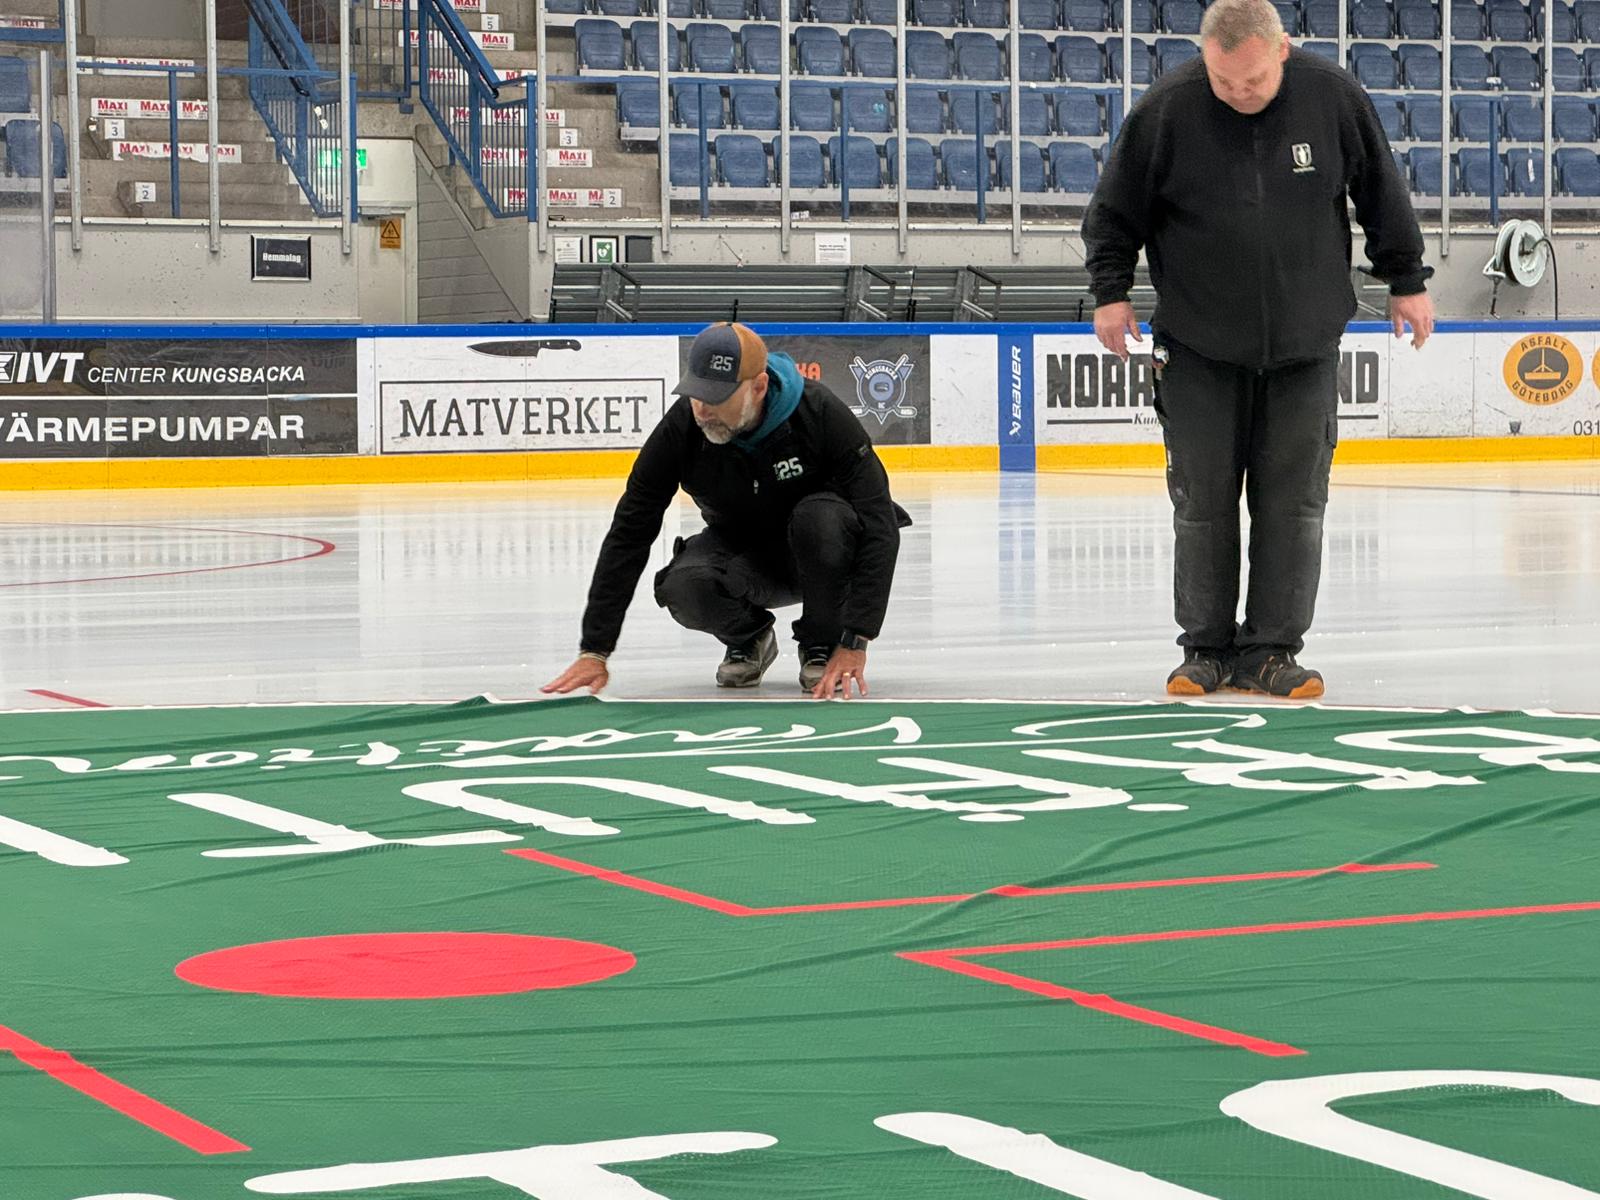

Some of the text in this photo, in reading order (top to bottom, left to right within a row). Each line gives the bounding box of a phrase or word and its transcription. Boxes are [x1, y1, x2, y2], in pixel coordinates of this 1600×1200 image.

[487, 21, 494, 29] 5
[482, 33, 509, 44] MAXI
[97, 99, 128, 111] MAXI
[182, 101, 209, 113] MAX
[111, 126, 119, 137] 3
[565, 135, 573, 146] 3
[119, 143, 150, 154] MAXI
[559, 150, 587, 161] MAXI
[141, 189, 150, 200] 2
[549, 190, 577, 201] MAXI
[608, 195, 617, 206] 2
[262, 252, 302, 263] Hemmalag
[1521, 336, 1567, 351] ASFALT
[17, 352, 306, 384] IVT CENTER KUNGSBACKA
[1011, 345, 1021, 420] BAUER
[1512, 380, 1573, 402] GÖTEBORG
[399, 396, 648, 437] MATVERKET
[0, 412, 305, 442] ÄRMEPUMPAR
